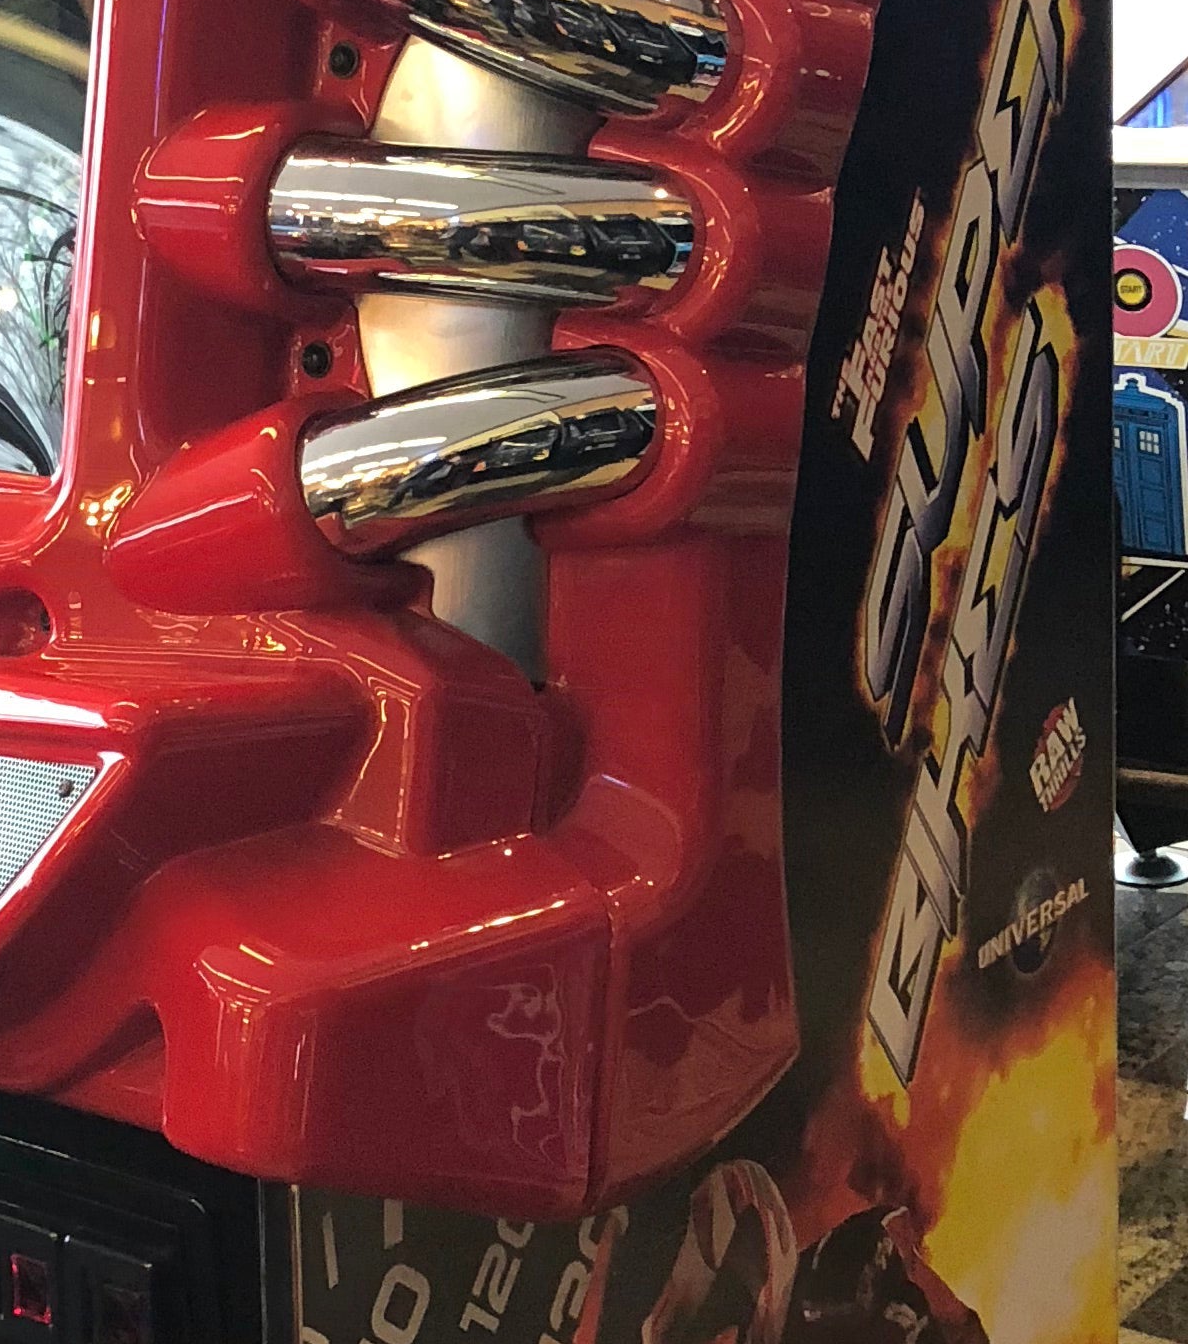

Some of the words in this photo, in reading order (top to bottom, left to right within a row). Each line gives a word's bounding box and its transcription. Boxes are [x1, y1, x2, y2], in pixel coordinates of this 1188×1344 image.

[845, 244, 893, 403] FAST
[850, 185, 926, 464] FURIOUS
[830, 357, 851, 421] THE
[867, 295, 1060, 1088] BIKES
[1028, 696, 1081, 796] RAW
[1037, 726, 1087, 813] THRILLS
[977, 877, 1091, 970] UNIVERSAL
